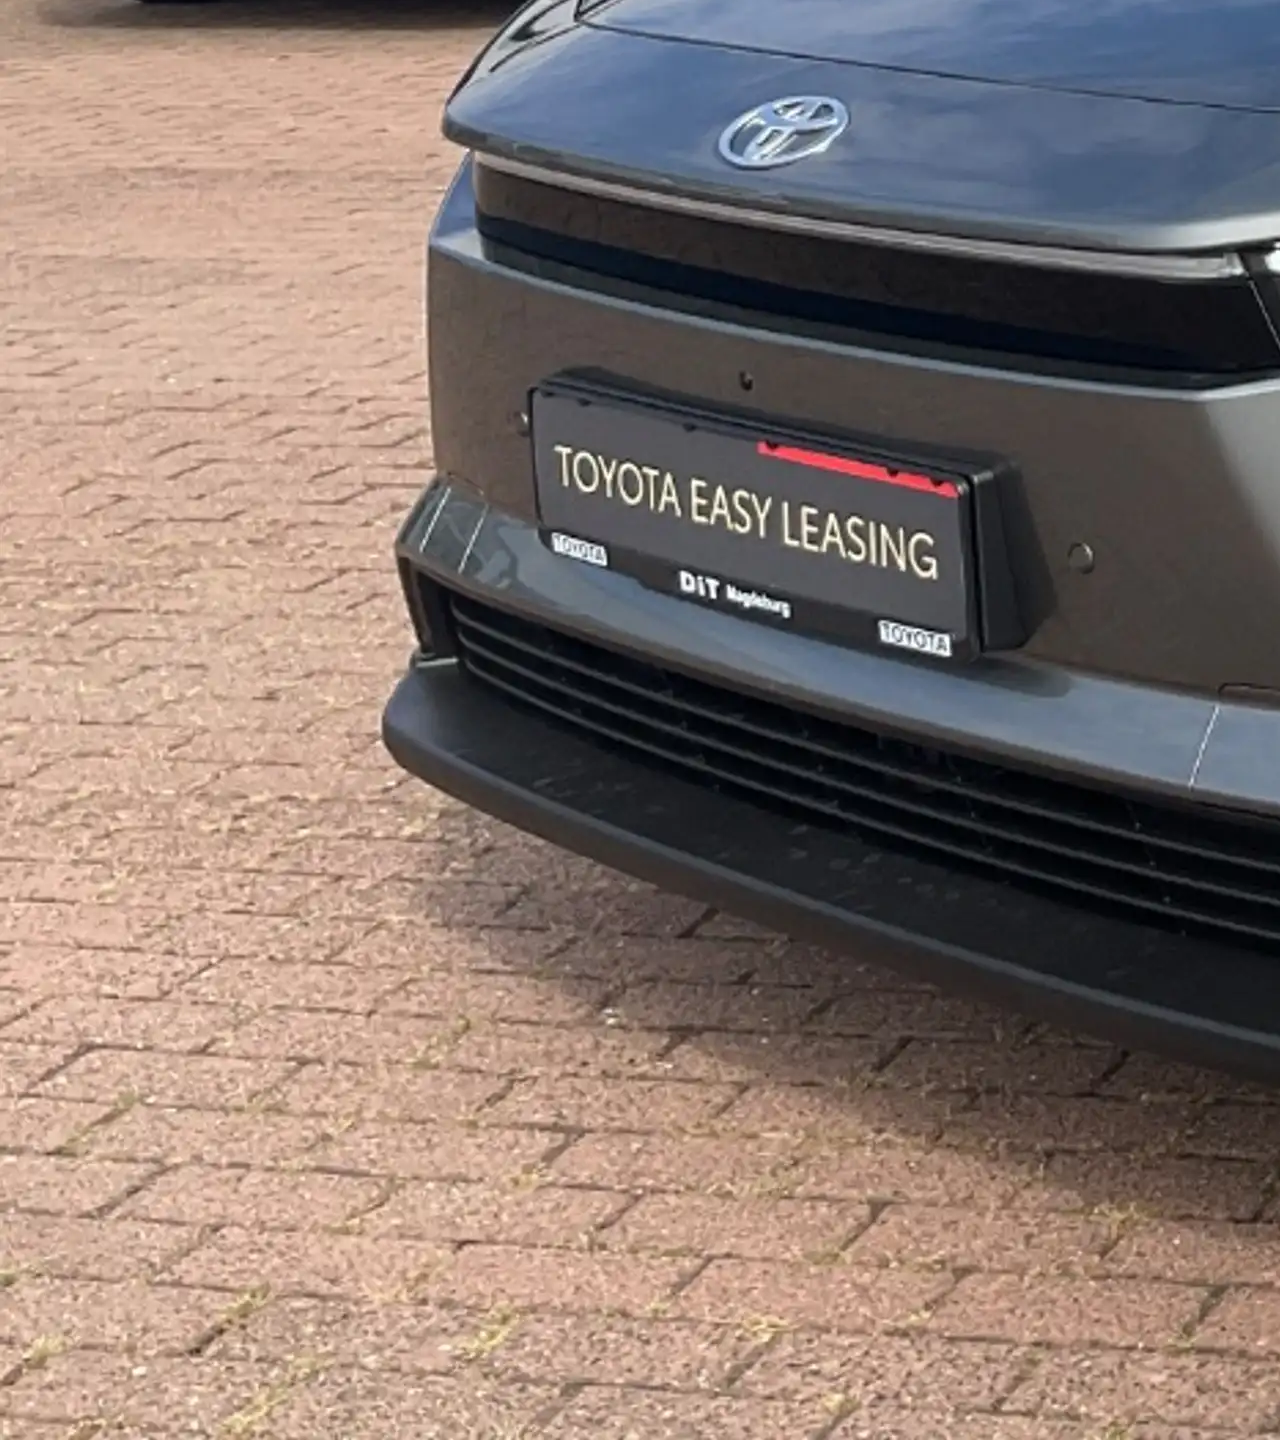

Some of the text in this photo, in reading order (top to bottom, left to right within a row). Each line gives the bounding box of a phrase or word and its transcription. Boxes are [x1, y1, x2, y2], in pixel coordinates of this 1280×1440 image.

[554, 445, 938, 580] TOYOTA EASY LEASING
[880, 621, 949, 654] TOYOTA
